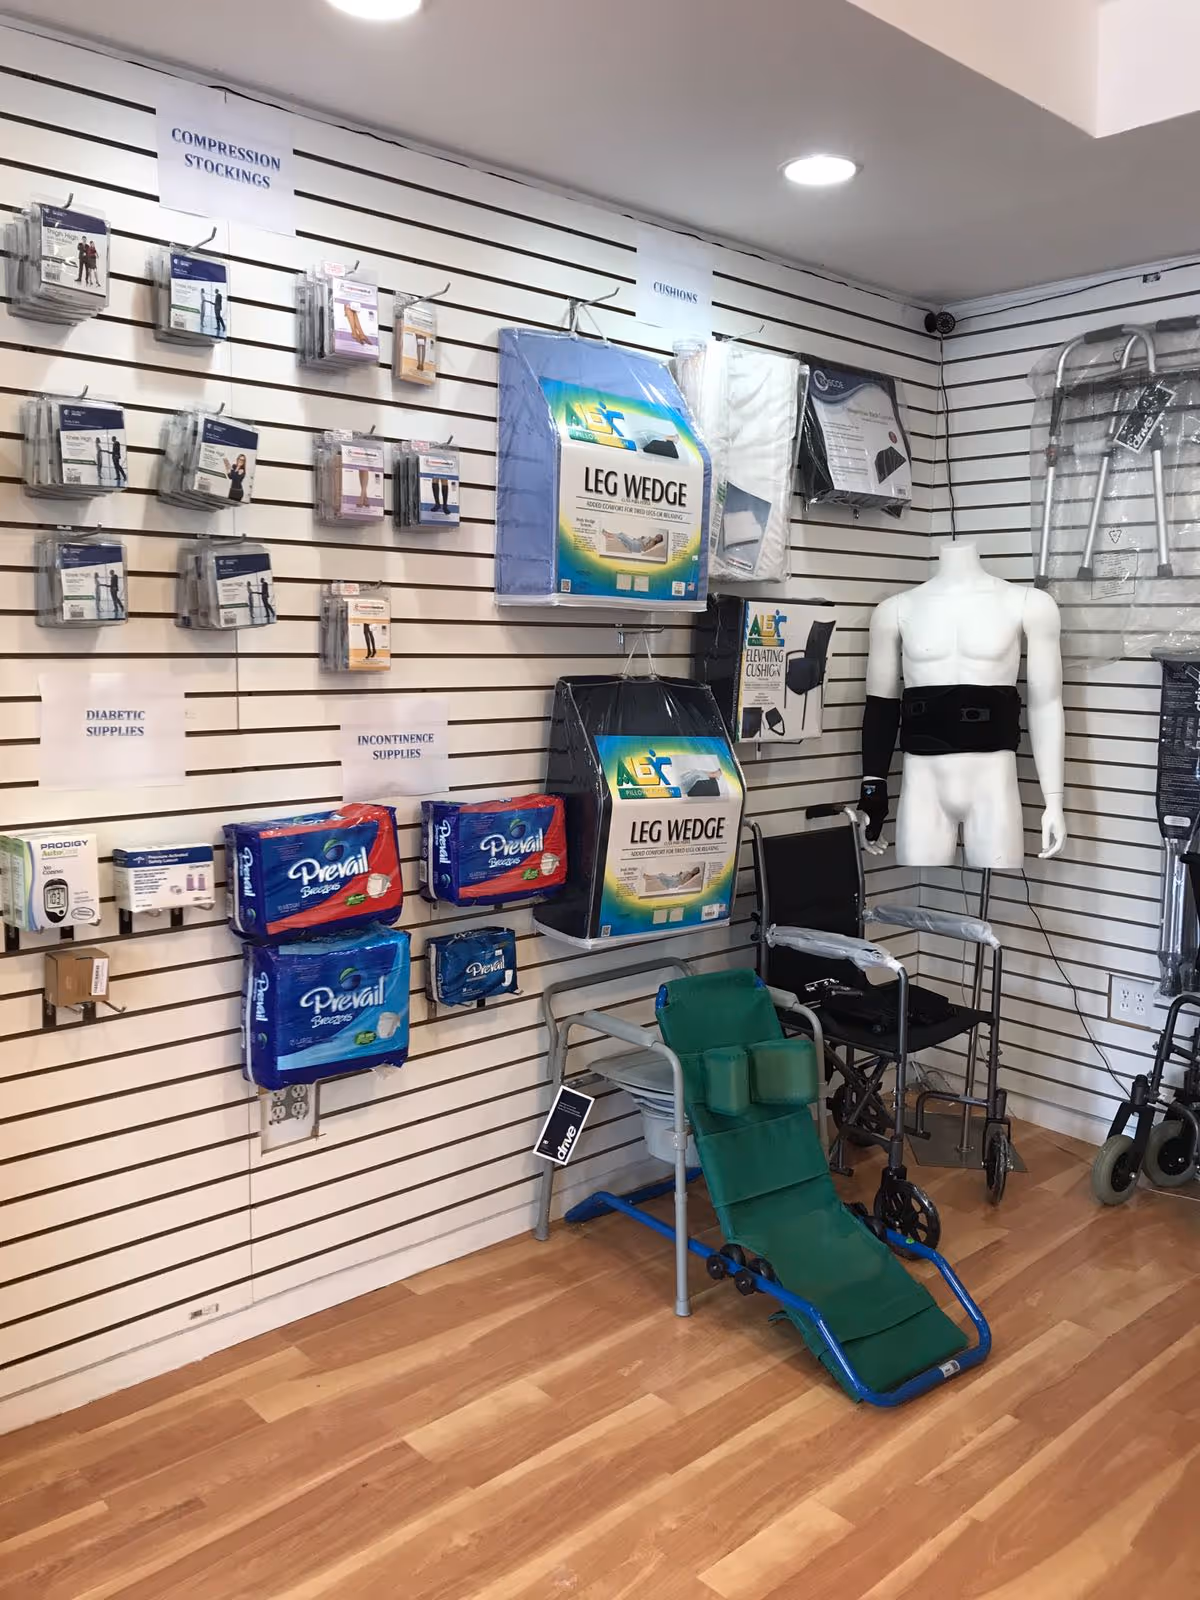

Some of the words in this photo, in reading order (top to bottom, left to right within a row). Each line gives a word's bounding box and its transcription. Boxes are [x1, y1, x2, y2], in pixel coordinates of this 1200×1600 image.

[172, 127, 280, 171] COMPRESSION
[184, 153, 270, 189] STOCKINGS
[653, 281, 698, 304] CUSHIONS
[1133, 416, 1154, 448] drive
[584, 466, 618, 497] LEG
[624, 473, 688, 507] WEDGE
[586, 500, 602, 509] ADDED
[602, 503, 624, 512] COMFORT
[624, 506, 634, 514] FOR
[634, 507, 646, 515] TIRED
[663, 512, 684, 520] RELAXING
[746, 649, 784, 662] ELEVATING
[746, 663, 781, 678] CUSHION
[86, 710, 146, 721] DIABETIC
[86, 726, 145, 736] SUPPLIES
[358, 733, 434, 746] INCONTINENCE
[372, 748, 421, 760] SUPPLIES
[630, 820, 662, 844] LEG
[667, 817, 726, 841] WEDGE
[40, 840, 88, 850] PRODIGY
[42, 849, 78, 857] Auto
[439, 820, 452, 864] Prevail
[480, 828, 544, 857] Prevail
[646, 848, 665, 856] COMFORT
[244, 847, 256, 897] Prevail
[288, 847, 370, 886] Prevail
[488, 856, 520, 868] Breezers
[301, 882, 341, 898] Breezers
[466, 955, 505, 977] Prevail
[256, 972, 270, 1022] Prevail
[300, 975, 385, 1014] Prevail
[310, 1014, 353, 1029] Breezers
[557, 1125, 577, 1160] drive
